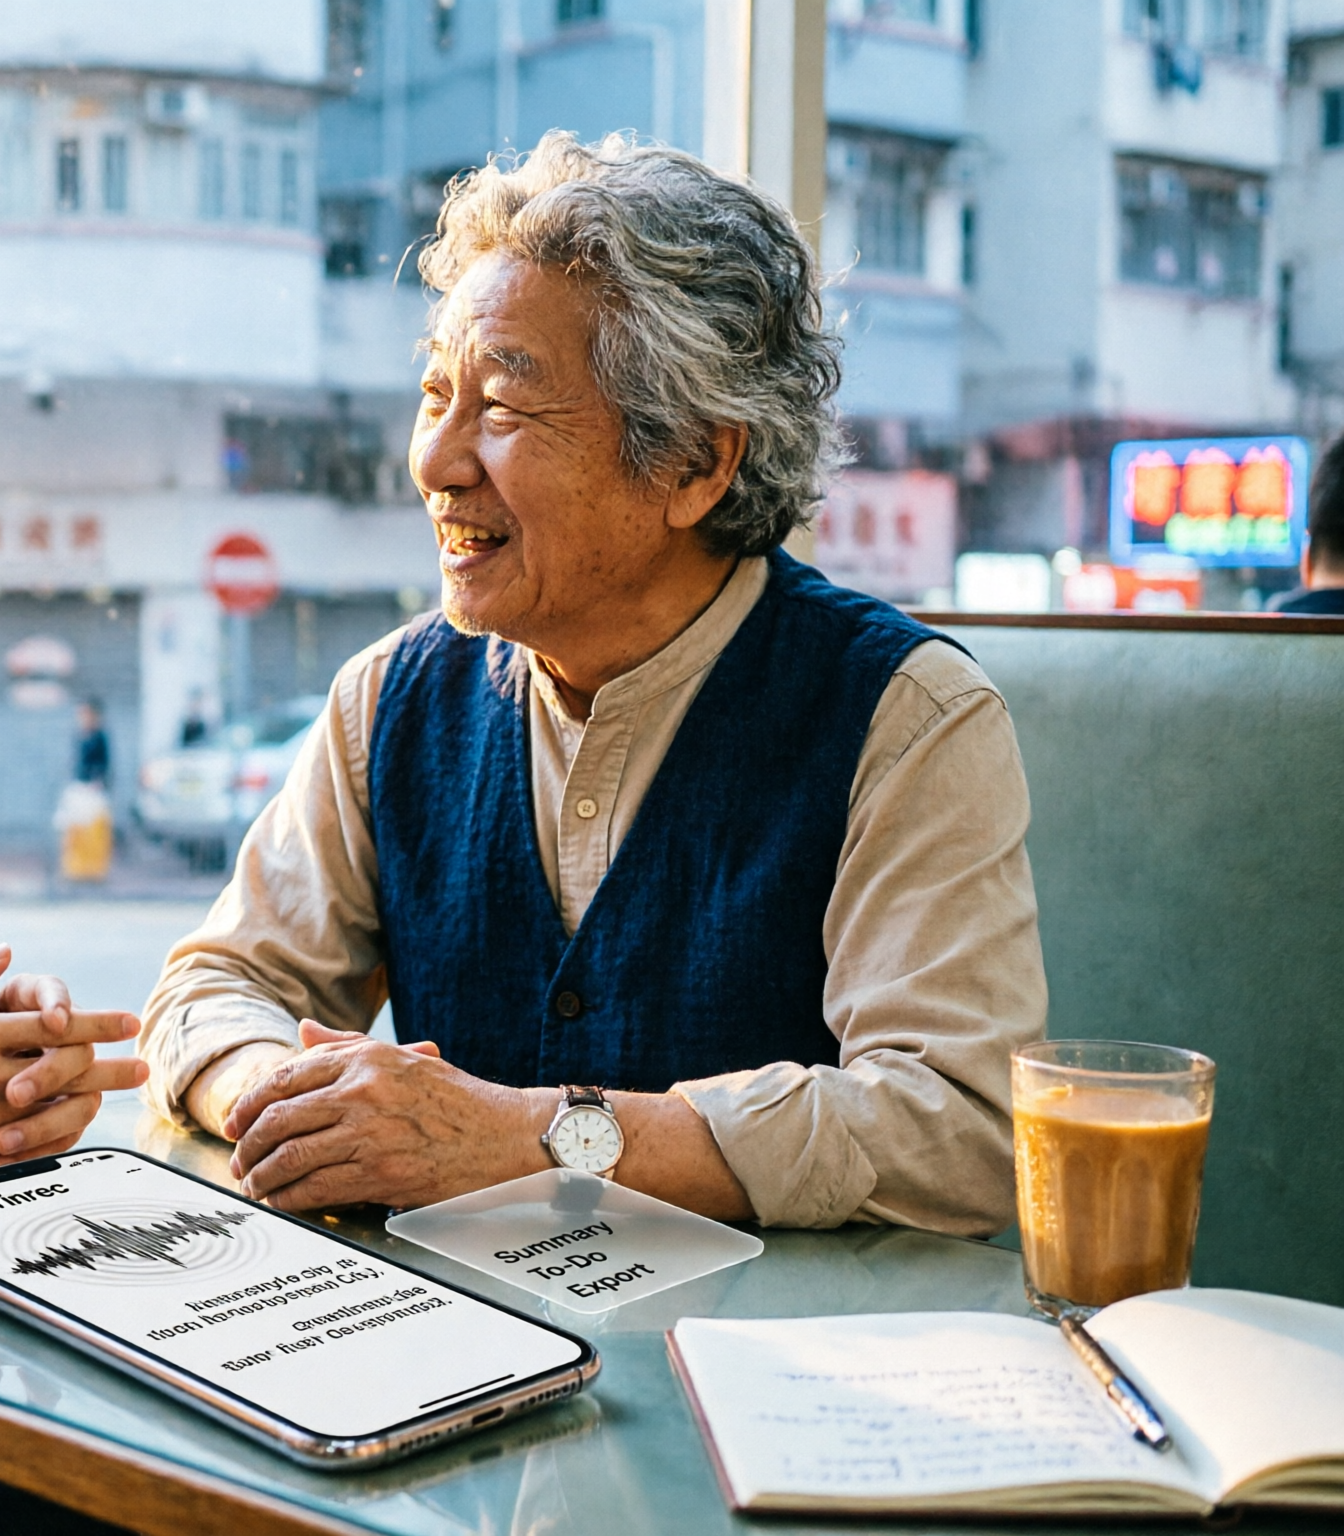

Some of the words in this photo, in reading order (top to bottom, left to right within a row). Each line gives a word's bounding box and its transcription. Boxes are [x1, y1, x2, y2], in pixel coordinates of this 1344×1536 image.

[493, 1221, 614, 1264] Summary
[526, 1251, 608, 1280] To-Do
[566, 1263, 655, 1298] Export
